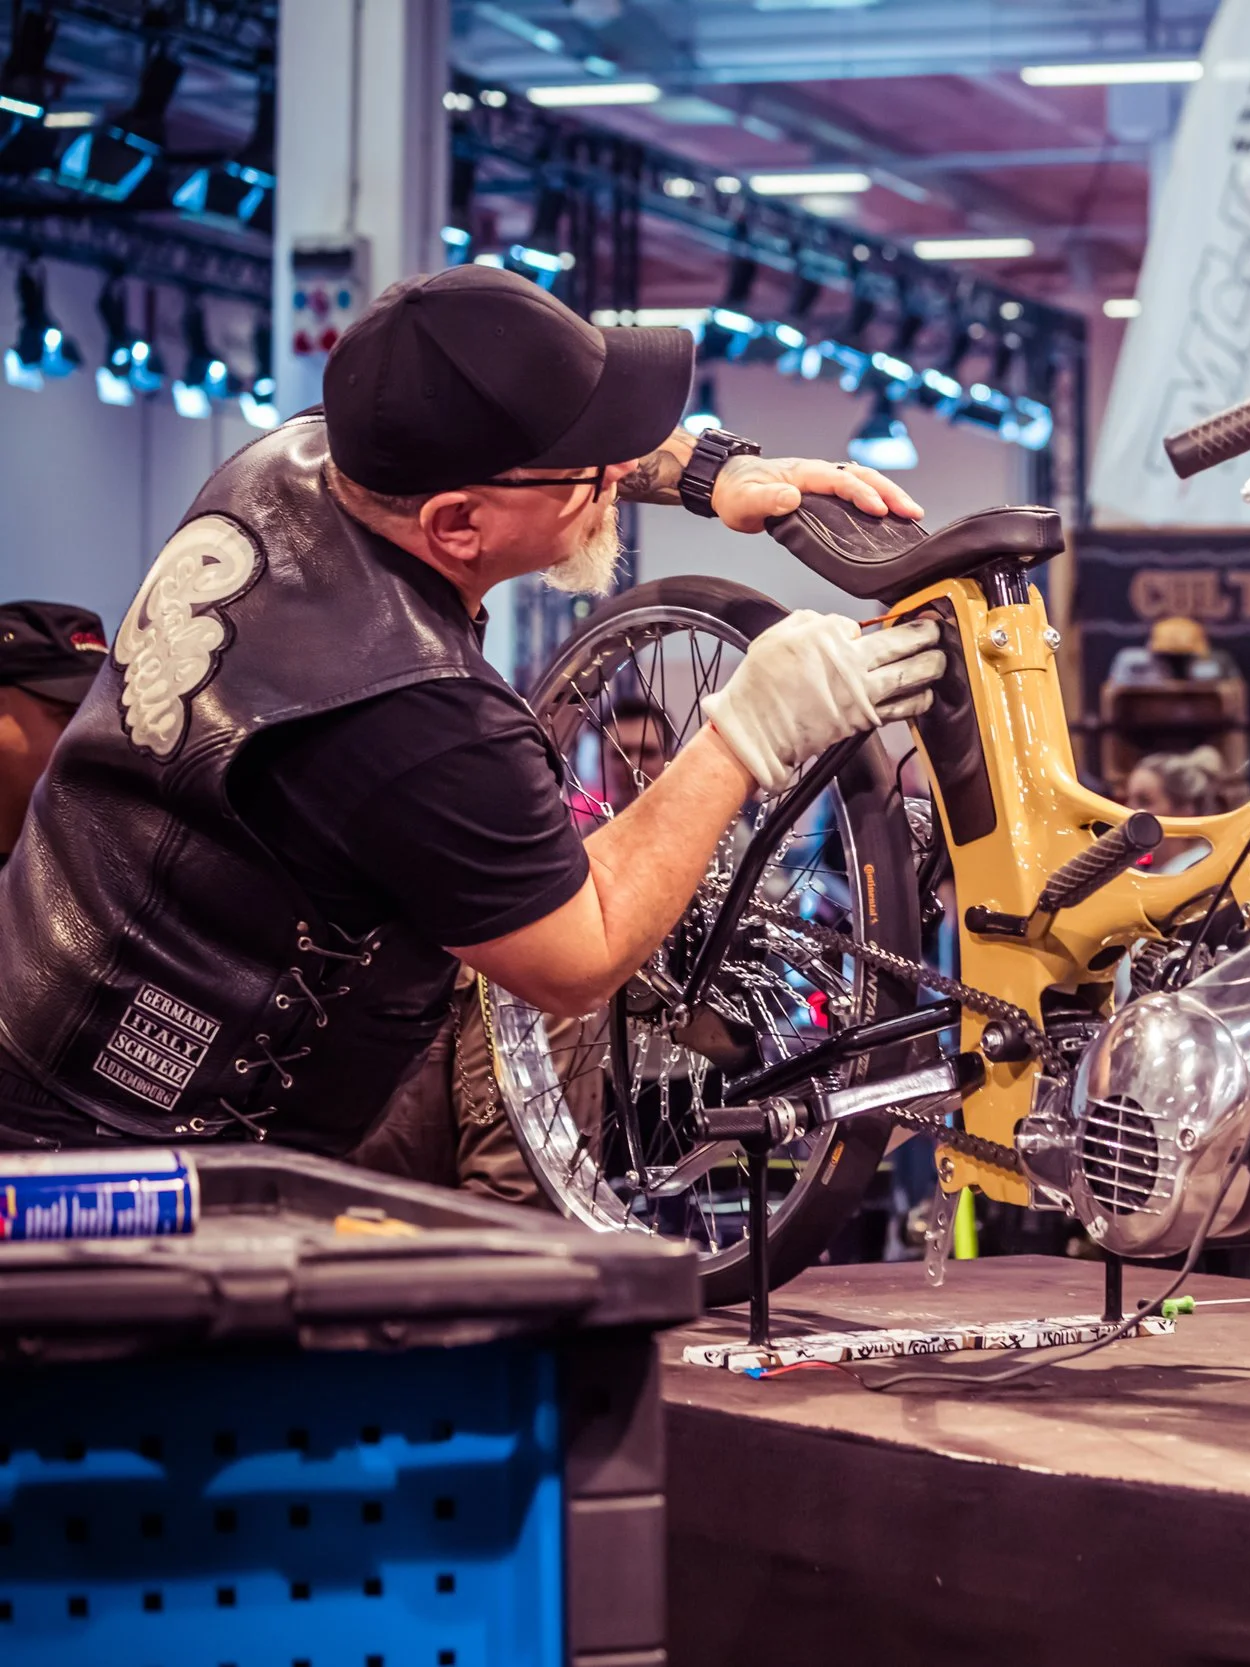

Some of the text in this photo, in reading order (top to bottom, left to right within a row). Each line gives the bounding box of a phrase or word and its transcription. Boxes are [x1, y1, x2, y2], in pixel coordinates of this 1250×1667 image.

[129, 1013, 199, 1058] ITALY
[142, 988, 216, 1037] GERMANY
[99, 1056, 175, 1104] LUXEMBOURG
[115, 1033, 188, 1083] SCHWEIZ
